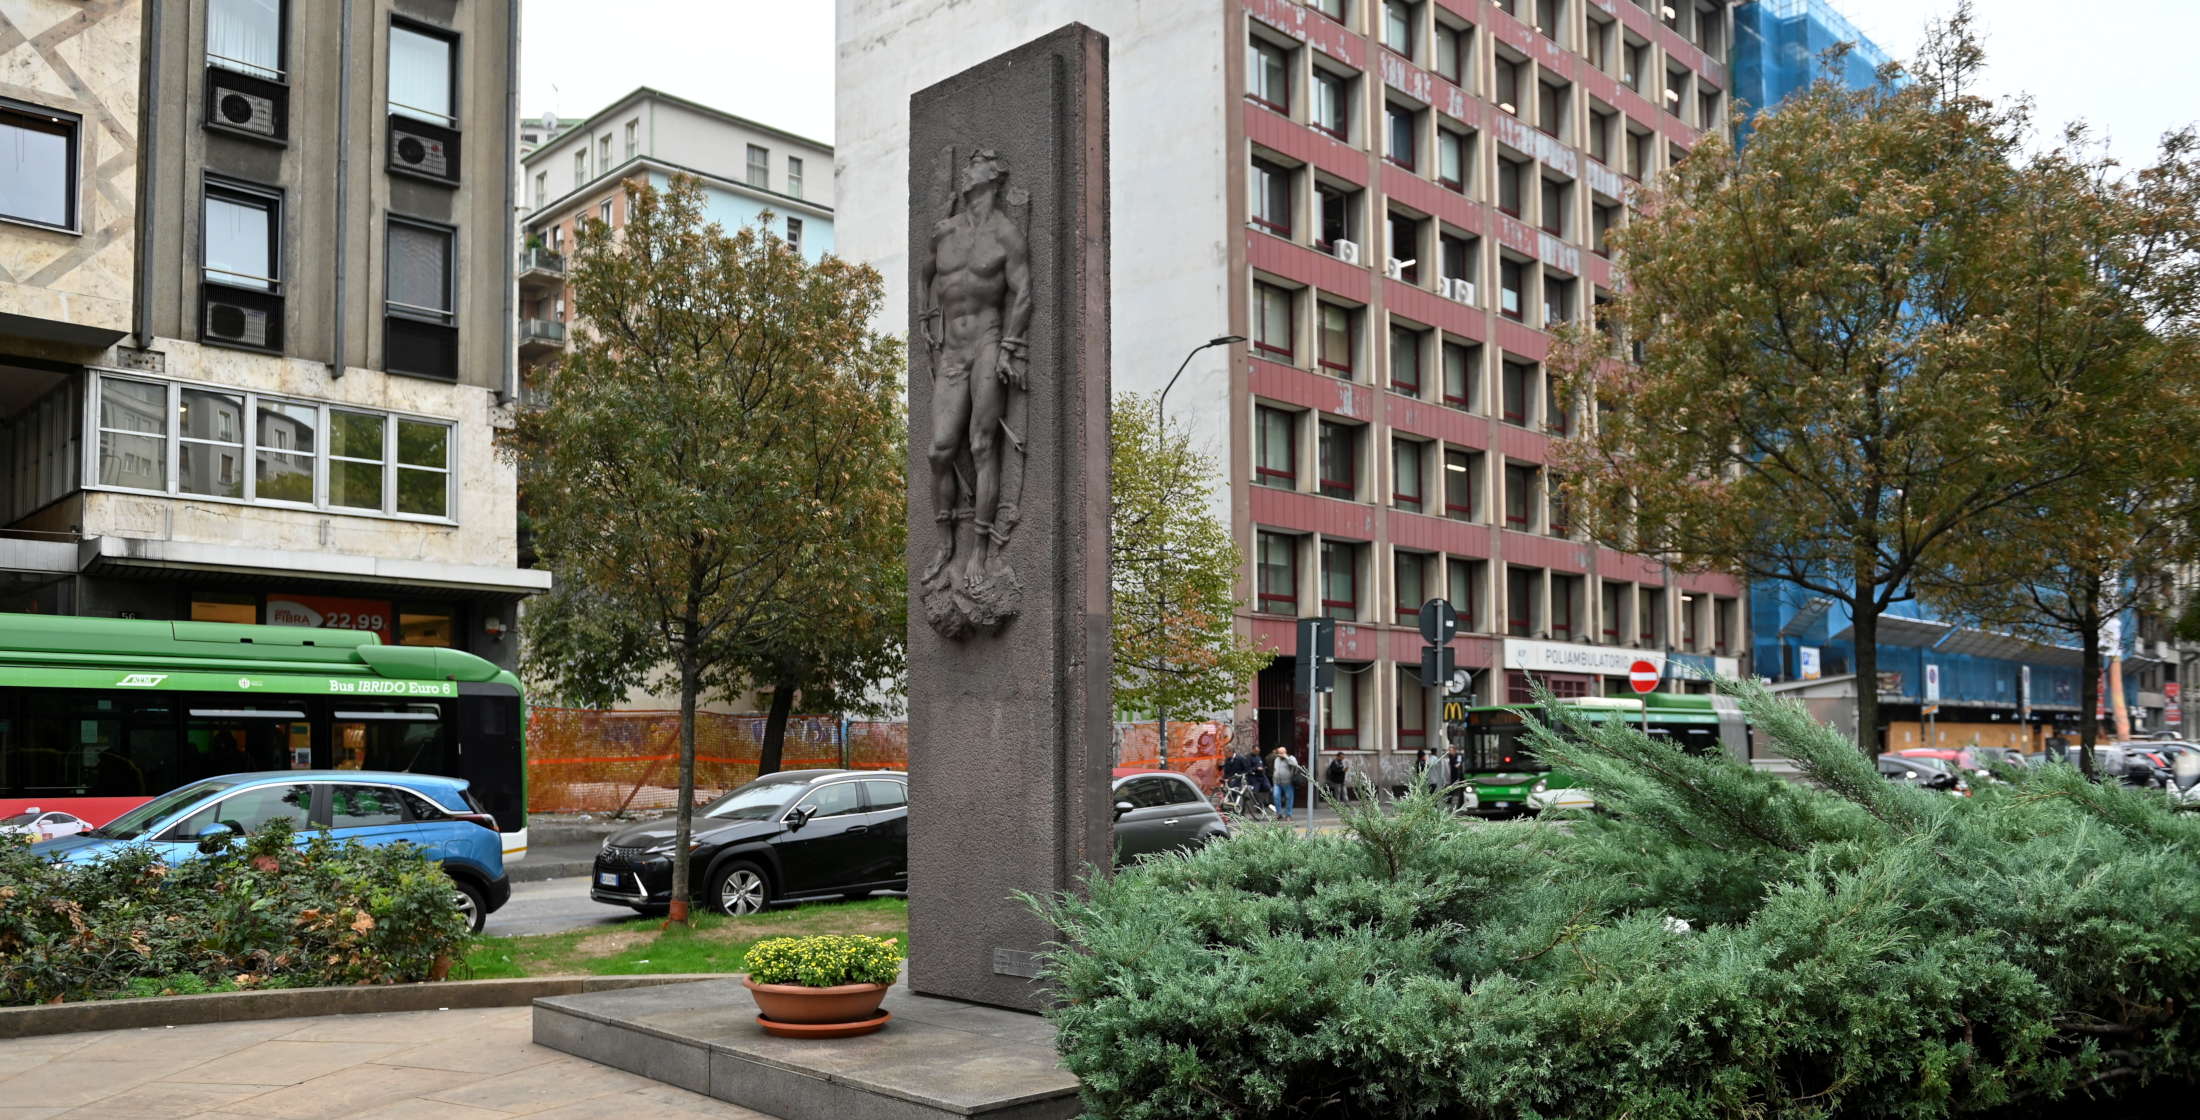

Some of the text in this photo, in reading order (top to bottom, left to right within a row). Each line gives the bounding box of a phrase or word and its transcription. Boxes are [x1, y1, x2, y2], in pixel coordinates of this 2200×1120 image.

[326, 612, 384, 630] 22,99
[1545, 648, 1630, 669] POLIAMBULATORIO
[329, 680, 450, 694] Bus IBRIDO Euro 6
